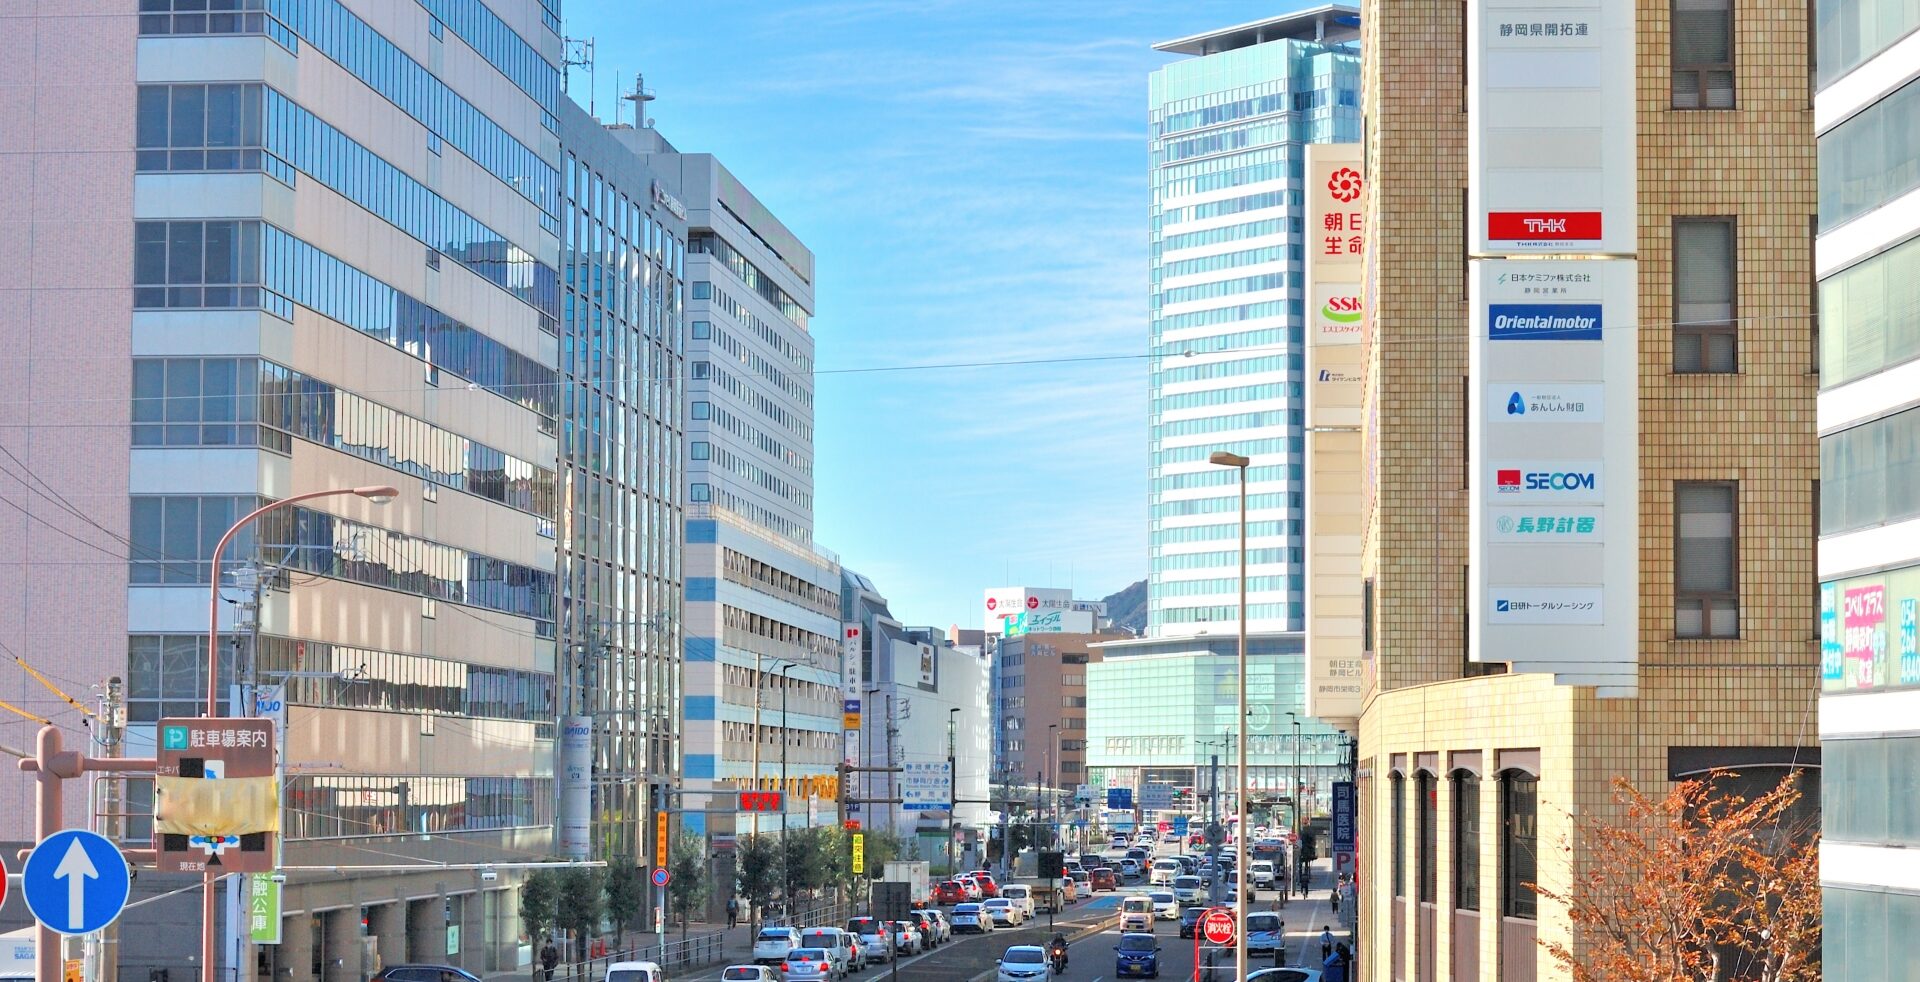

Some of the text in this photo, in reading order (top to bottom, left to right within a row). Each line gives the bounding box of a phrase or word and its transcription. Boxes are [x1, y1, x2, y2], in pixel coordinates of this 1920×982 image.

[1499, 23, 1589, 37] 静岡県開拓連
[1523, 218, 1567, 233] THK
[1511, 273, 1592, 283] 日本ケミファ株式会社
[1530, 402, 1584, 412] あんしん財団
[1525, 472, 1595, 490] SECOM
[1516, 516, 1596, 533] 長野計器
[1510, 601, 1594, 611] 日研トータルソーシング
[190, 729, 268, 748] 駐車場案内
[1336, 785, 1350, 840] 司馬医院
[1336, 852, 1351, 871] P
[1206, 921, 1232, 934] 消火栓
